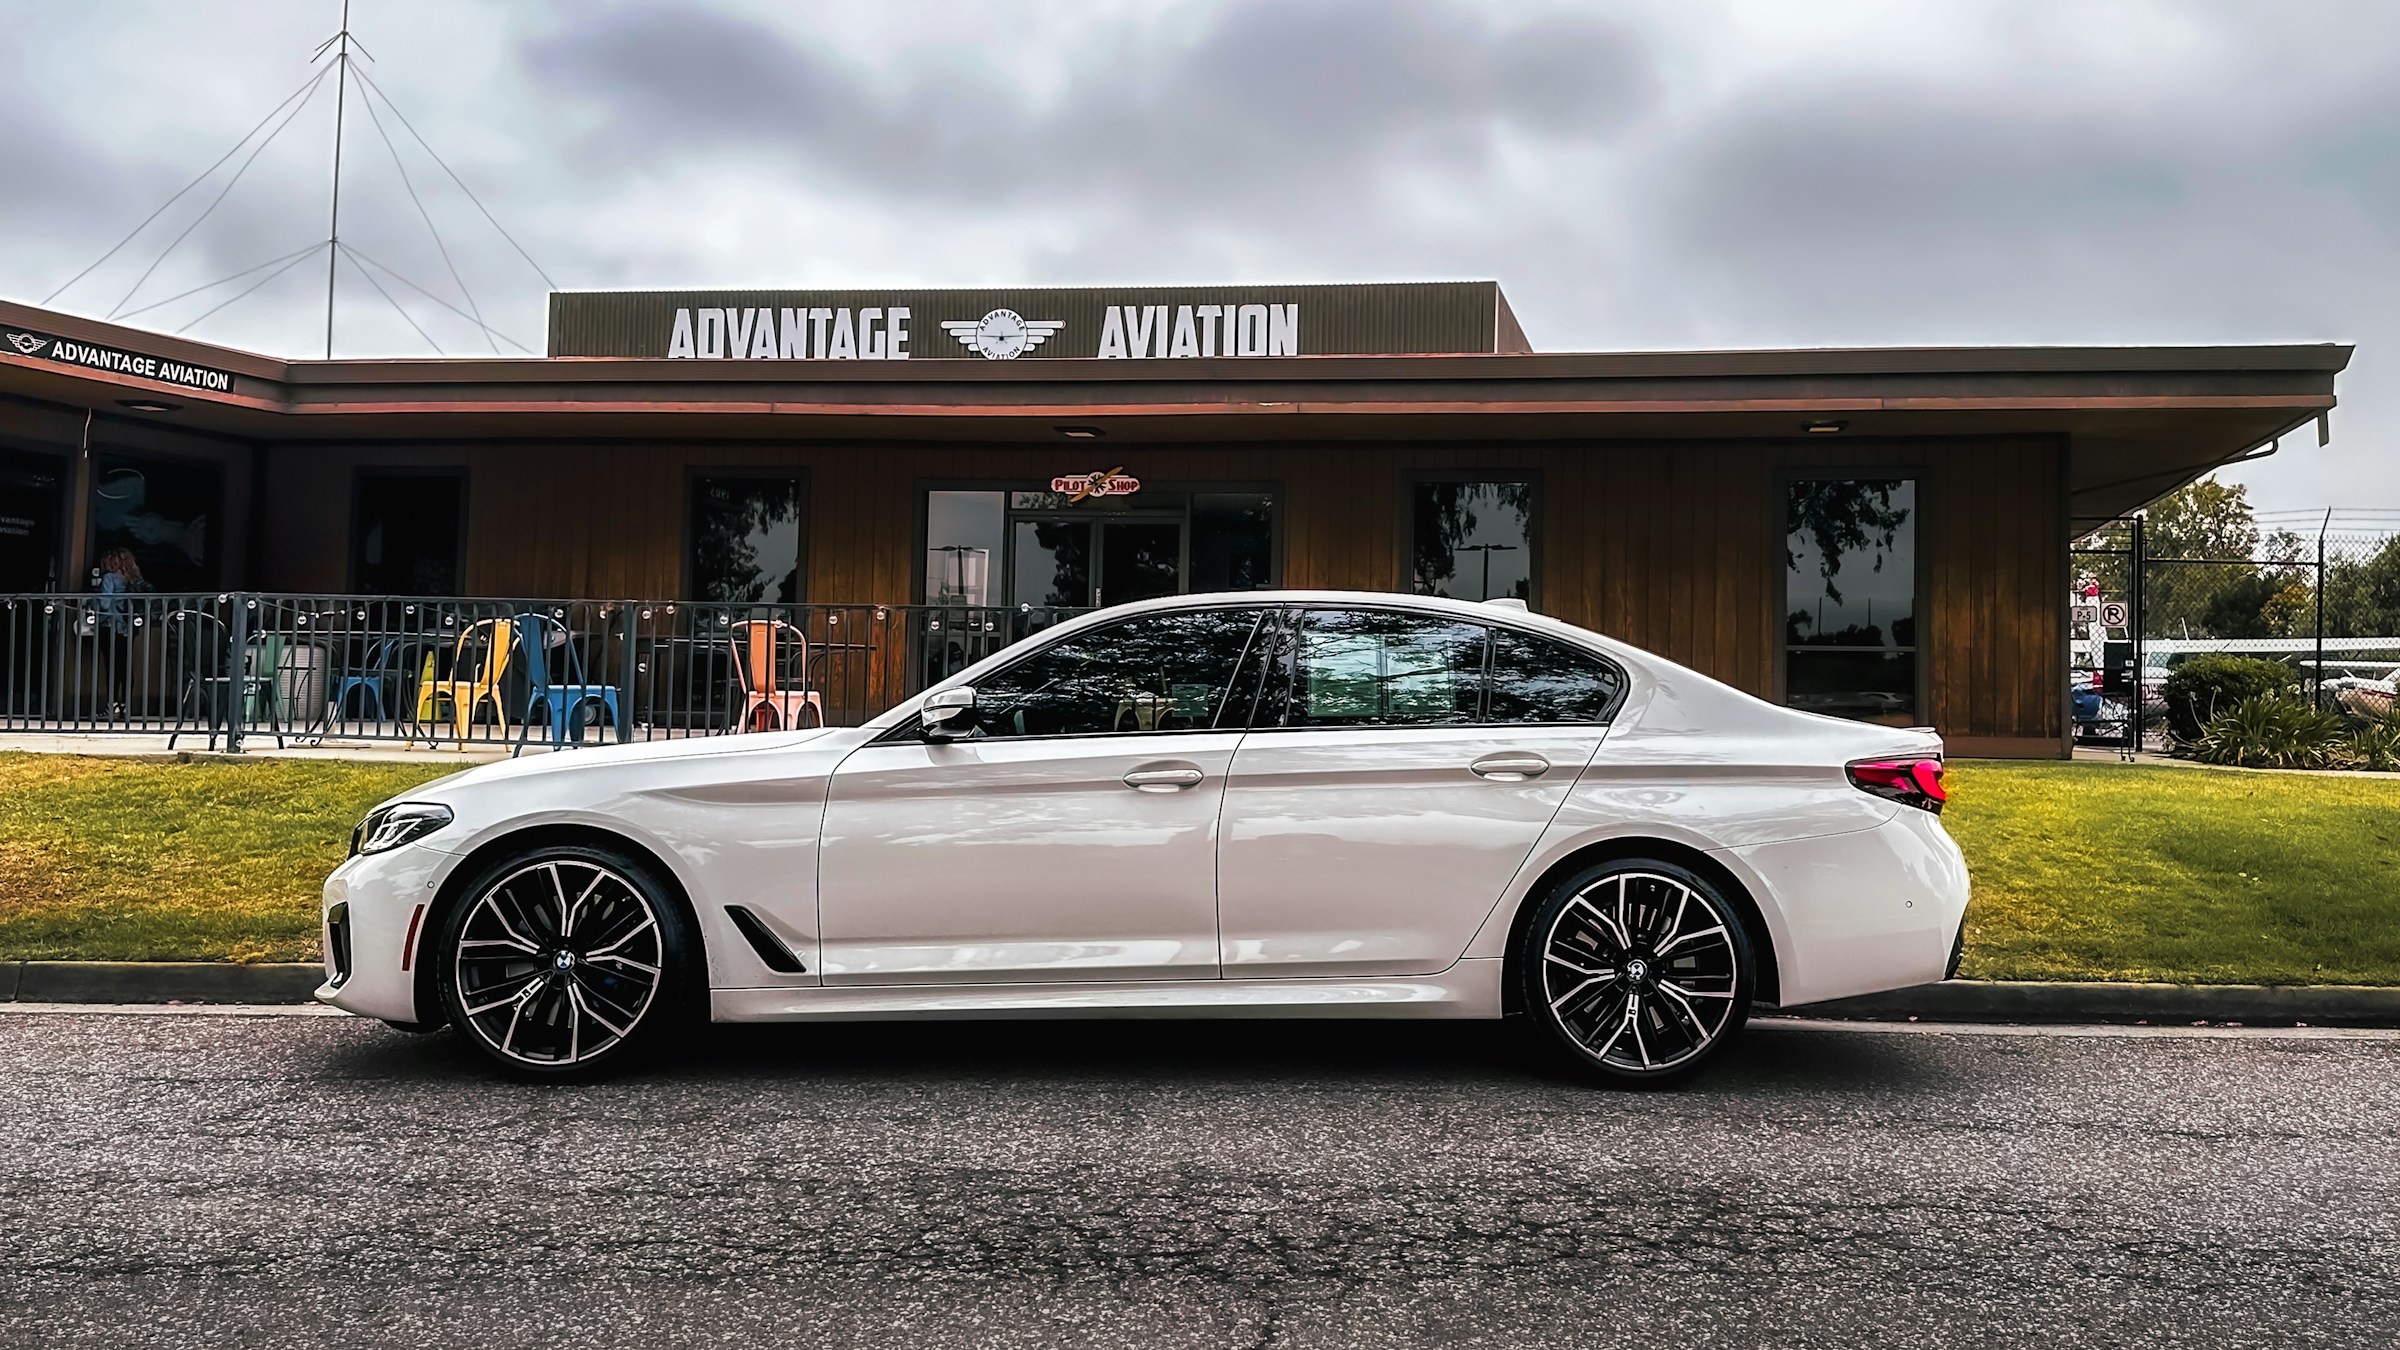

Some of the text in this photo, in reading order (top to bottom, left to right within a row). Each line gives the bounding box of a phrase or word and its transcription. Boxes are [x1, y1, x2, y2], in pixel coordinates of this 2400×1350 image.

[668, 303, 1298, 359] ADVANTAGE AVIATION
[979, 310, 1025, 331] ADVANTAGE
[982, 346, 1020, 359] AVIATION
[51, 341, 155, 376] ADVANTAGE
[158, 362, 228, 390] AVIATION
[1055, 479, 1138, 491] PILOT SHOP
